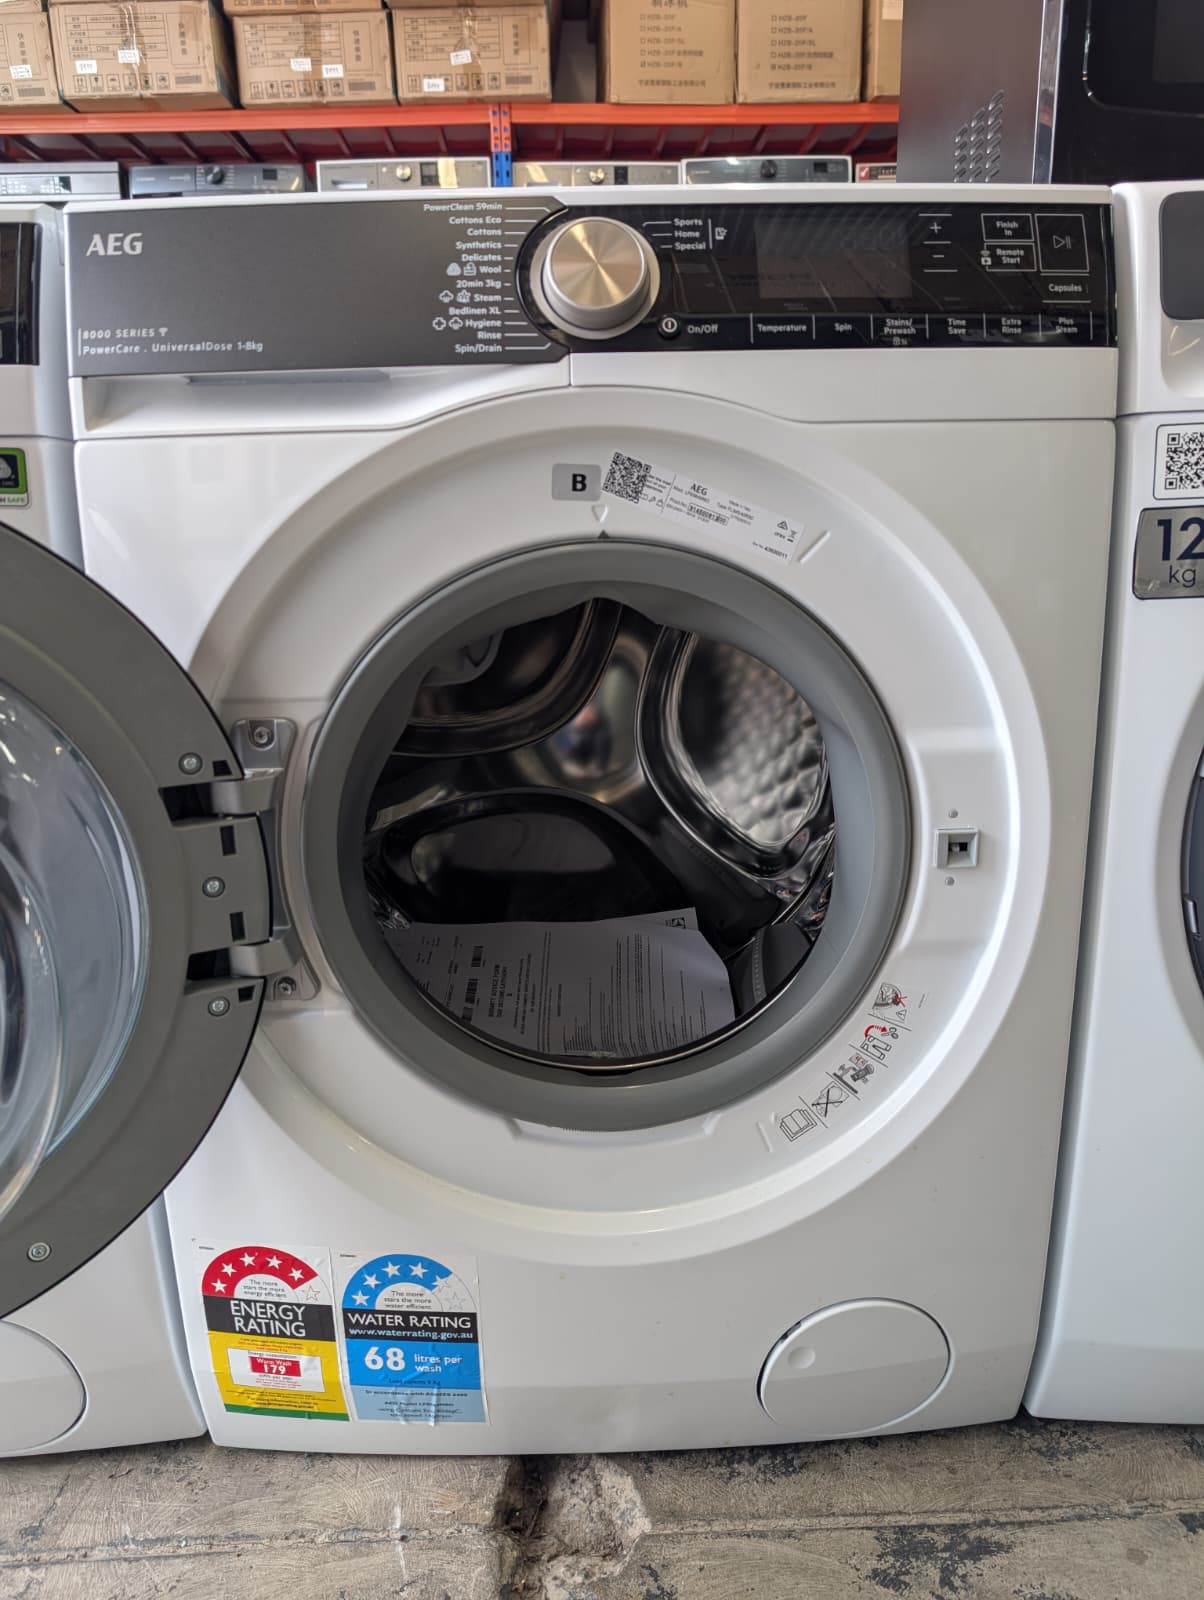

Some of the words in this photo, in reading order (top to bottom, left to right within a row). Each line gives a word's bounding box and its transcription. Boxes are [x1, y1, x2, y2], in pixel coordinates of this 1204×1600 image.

[424, 204, 474, 212] PowerClean
[476, 203, 502, 211] 59min
[449, 216, 483, 224] Cottons
[486, 216, 502, 224] Eco
[674, 218, 703, 227] Sports
[996, 221, 1019, 229] Finish
[467, 228, 502, 236] Cottons
[675, 230, 700, 238] Home
[85, 232, 144, 256] AEG
[456, 241, 502, 250] Synthetics
[675, 242, 706, 251] Special
[1002, 256, 1021, 264] Start
[480, 266, 502, 274] Wool
[486, 280, 502, 289] 3kg
[1049, 284, 1082, 293] Capsules
[474, 294, 502, 302] Steam
[449, 307, 487, 315] Bedlinen
[489, 307, 502, 315] XL
[465, 320, 502, 328] Hygiene
[886, 318, 913, 327] Stains/
[948, 318, 967, 326] Time
[1002, 318, 1022, 326] Extra
[1058, 317, 1074, 326] Plus
[687, 324, 719, 334] On/Off
[757, 324, 807, 333] Temperature
[834, 323, 853, 332] Spin
[884, 326, 916, 335] Prewash
[948, 326, 967, 334] Save
[1002, 326, 1022, 334] Rinse
[1055, 325, 1078, 334] Steam
[82, 330, 112, 340] 8000
[115, 329, 155, 338] SERIES
[83, 344, 140, 355] PowerCare
[152, 342, 233, 353] UniversalDose
[237, 340, 264, 353] 1-8kg
[455, 344, 503, 353] Spin/Drain
[572, 473, 587, 492] B
[690, 483, 708, 496] AEG
[1157, 517, 1204, 562] 12
[1169, 565, 1196, 588] kg
[230, 1300, 306, 1321] ENERGY
[347, 1312, 405, 1327] WATER
[409, 1315, 472, 1329] RATING
[234, 1317, 306, 1337] RATING
[349, 1328, 473, 1340] www.waterrating.gov.au
[257, 1357, 274, 1365] Warm
[364, 1346, 406, 1372] 68
[414, 1354, 440, 1364] litres
[444, 1355, 463, 1366] per
[264, 1365, 286, 1375] 179
[415, 1365, 442, 1373] wash
